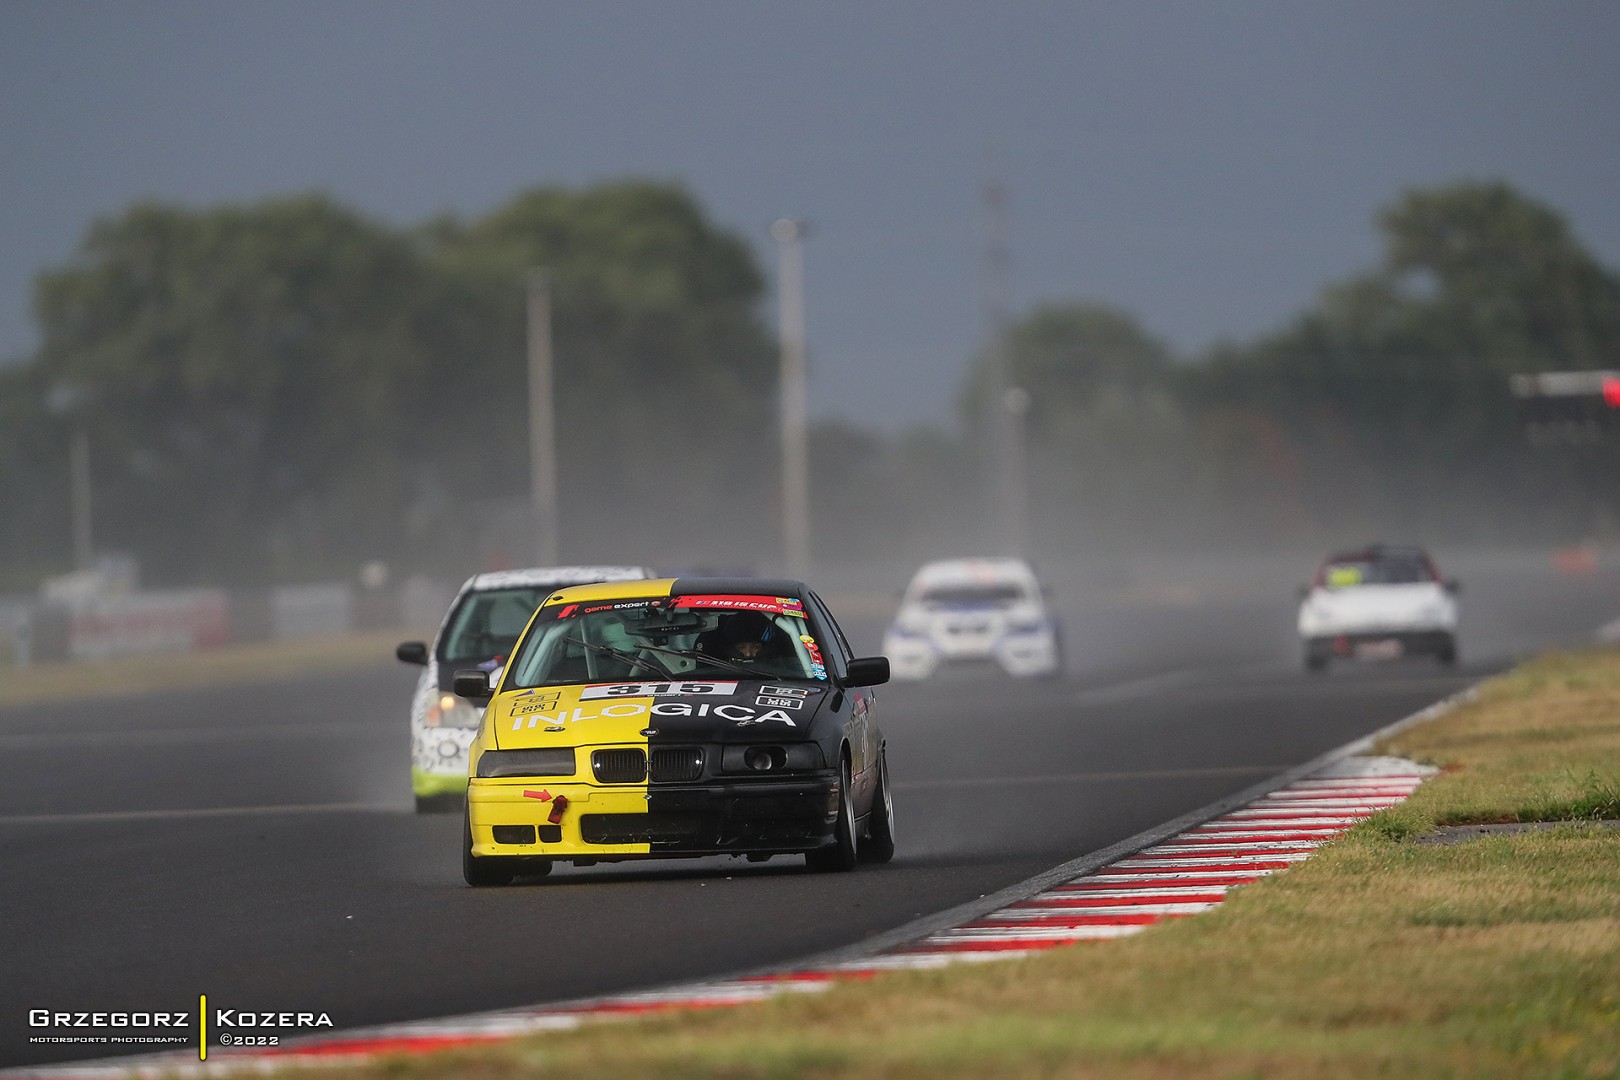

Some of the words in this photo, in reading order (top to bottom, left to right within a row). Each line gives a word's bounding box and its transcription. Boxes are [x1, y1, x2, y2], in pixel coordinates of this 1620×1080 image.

[614, 601, 650, 609] expert
[607, 683, 715, 696] 315
[512, 702, 797, 731] INLOGICA
